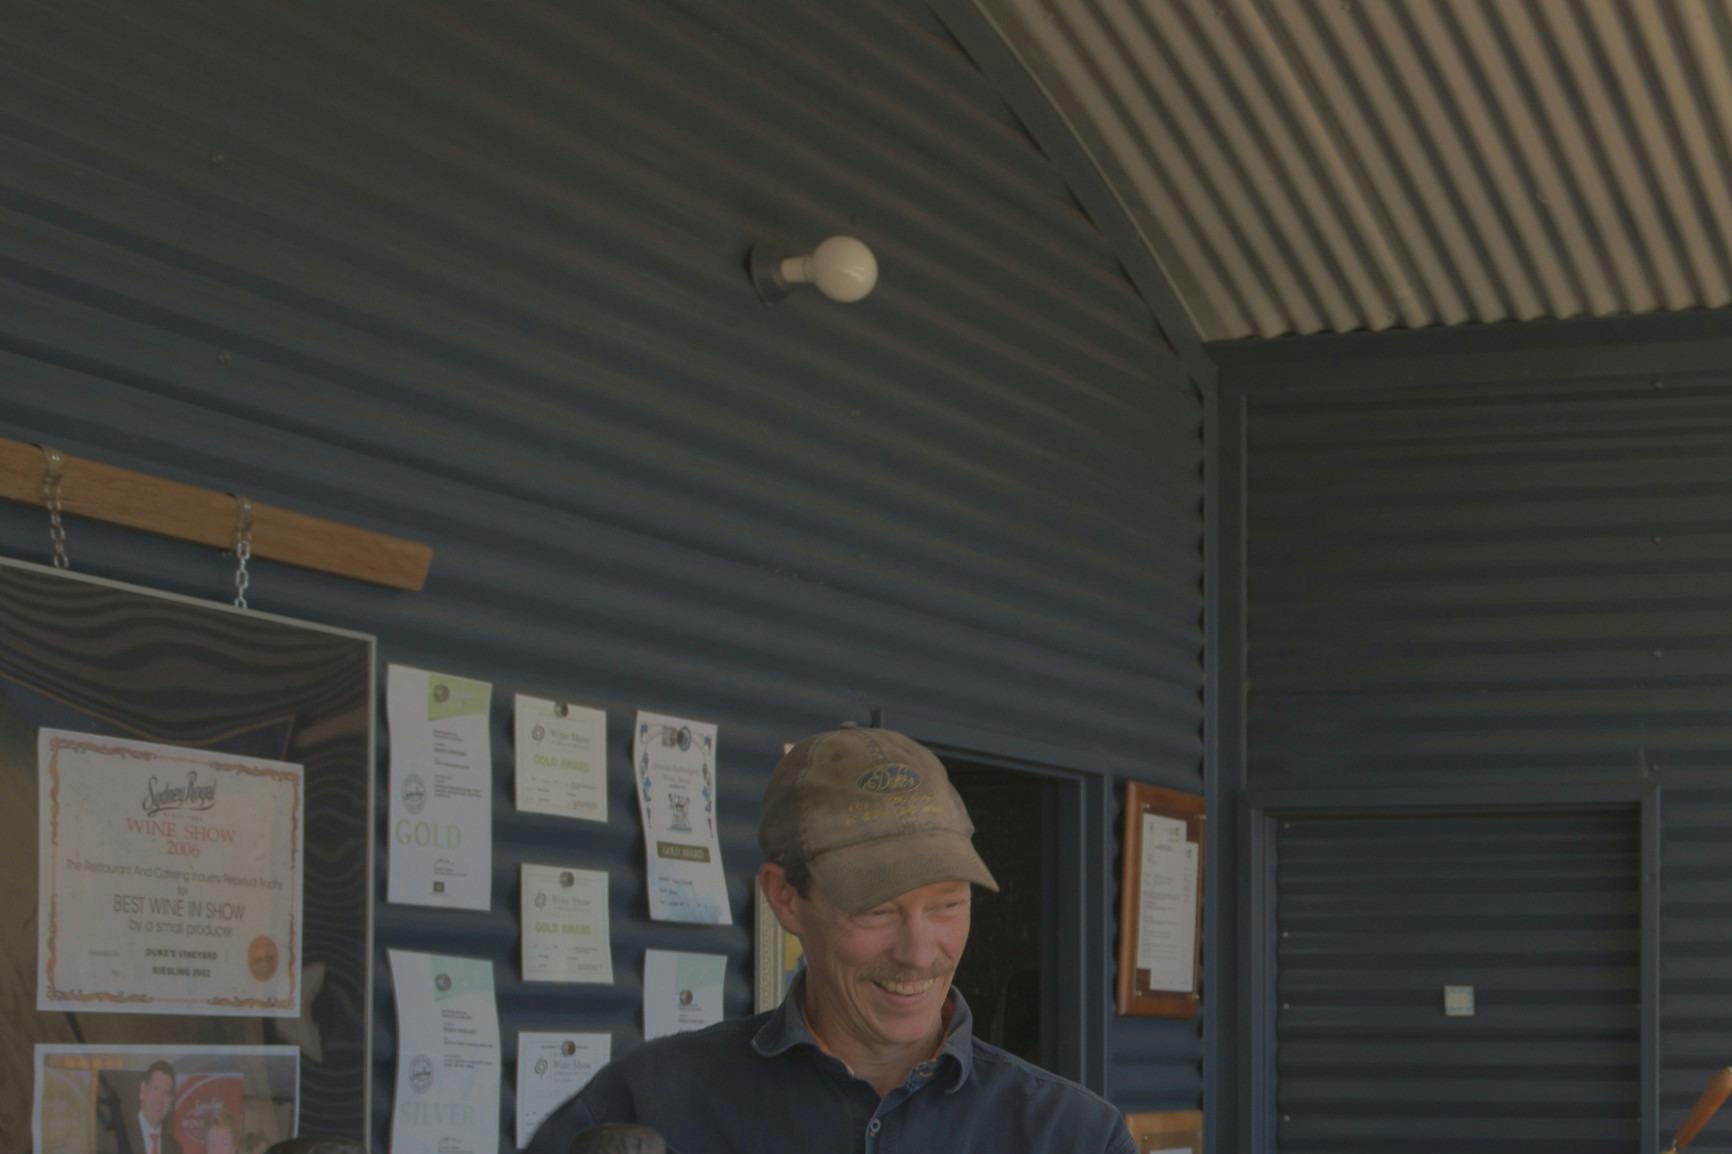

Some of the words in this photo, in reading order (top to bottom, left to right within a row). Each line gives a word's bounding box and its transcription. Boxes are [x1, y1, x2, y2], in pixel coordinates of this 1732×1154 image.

[181, 770, 217, 811] Royal
[126, 818, 176, 838] WINE
[184, 824, 236, 844] SHOW
[395, 819, 463, 849] GOLD
[167, 840, 201, 857] 2006
[66, 859, 83, 872] The
[84, 860, 132, 876] Restaurant
[134, 864, 152, 878] And
[154, 866, 190, 882] Catering
[113, 893, 145, 914] BEST
[150, 897, 184, 917] WINE
[188, 900, 203, 919] IN
[206, 902, 247, 922] SHOW
[128, 917, 142, 934] by
[144, 921, 155, 932] a
[155, 921, 184, 935] small
[186, 923, 233, 939] producer
[178, 949, 219, 961] VINEYARD
[152, 966, 191, 977] RIESLING
[400, 1102, 475, 1127] SILVER
